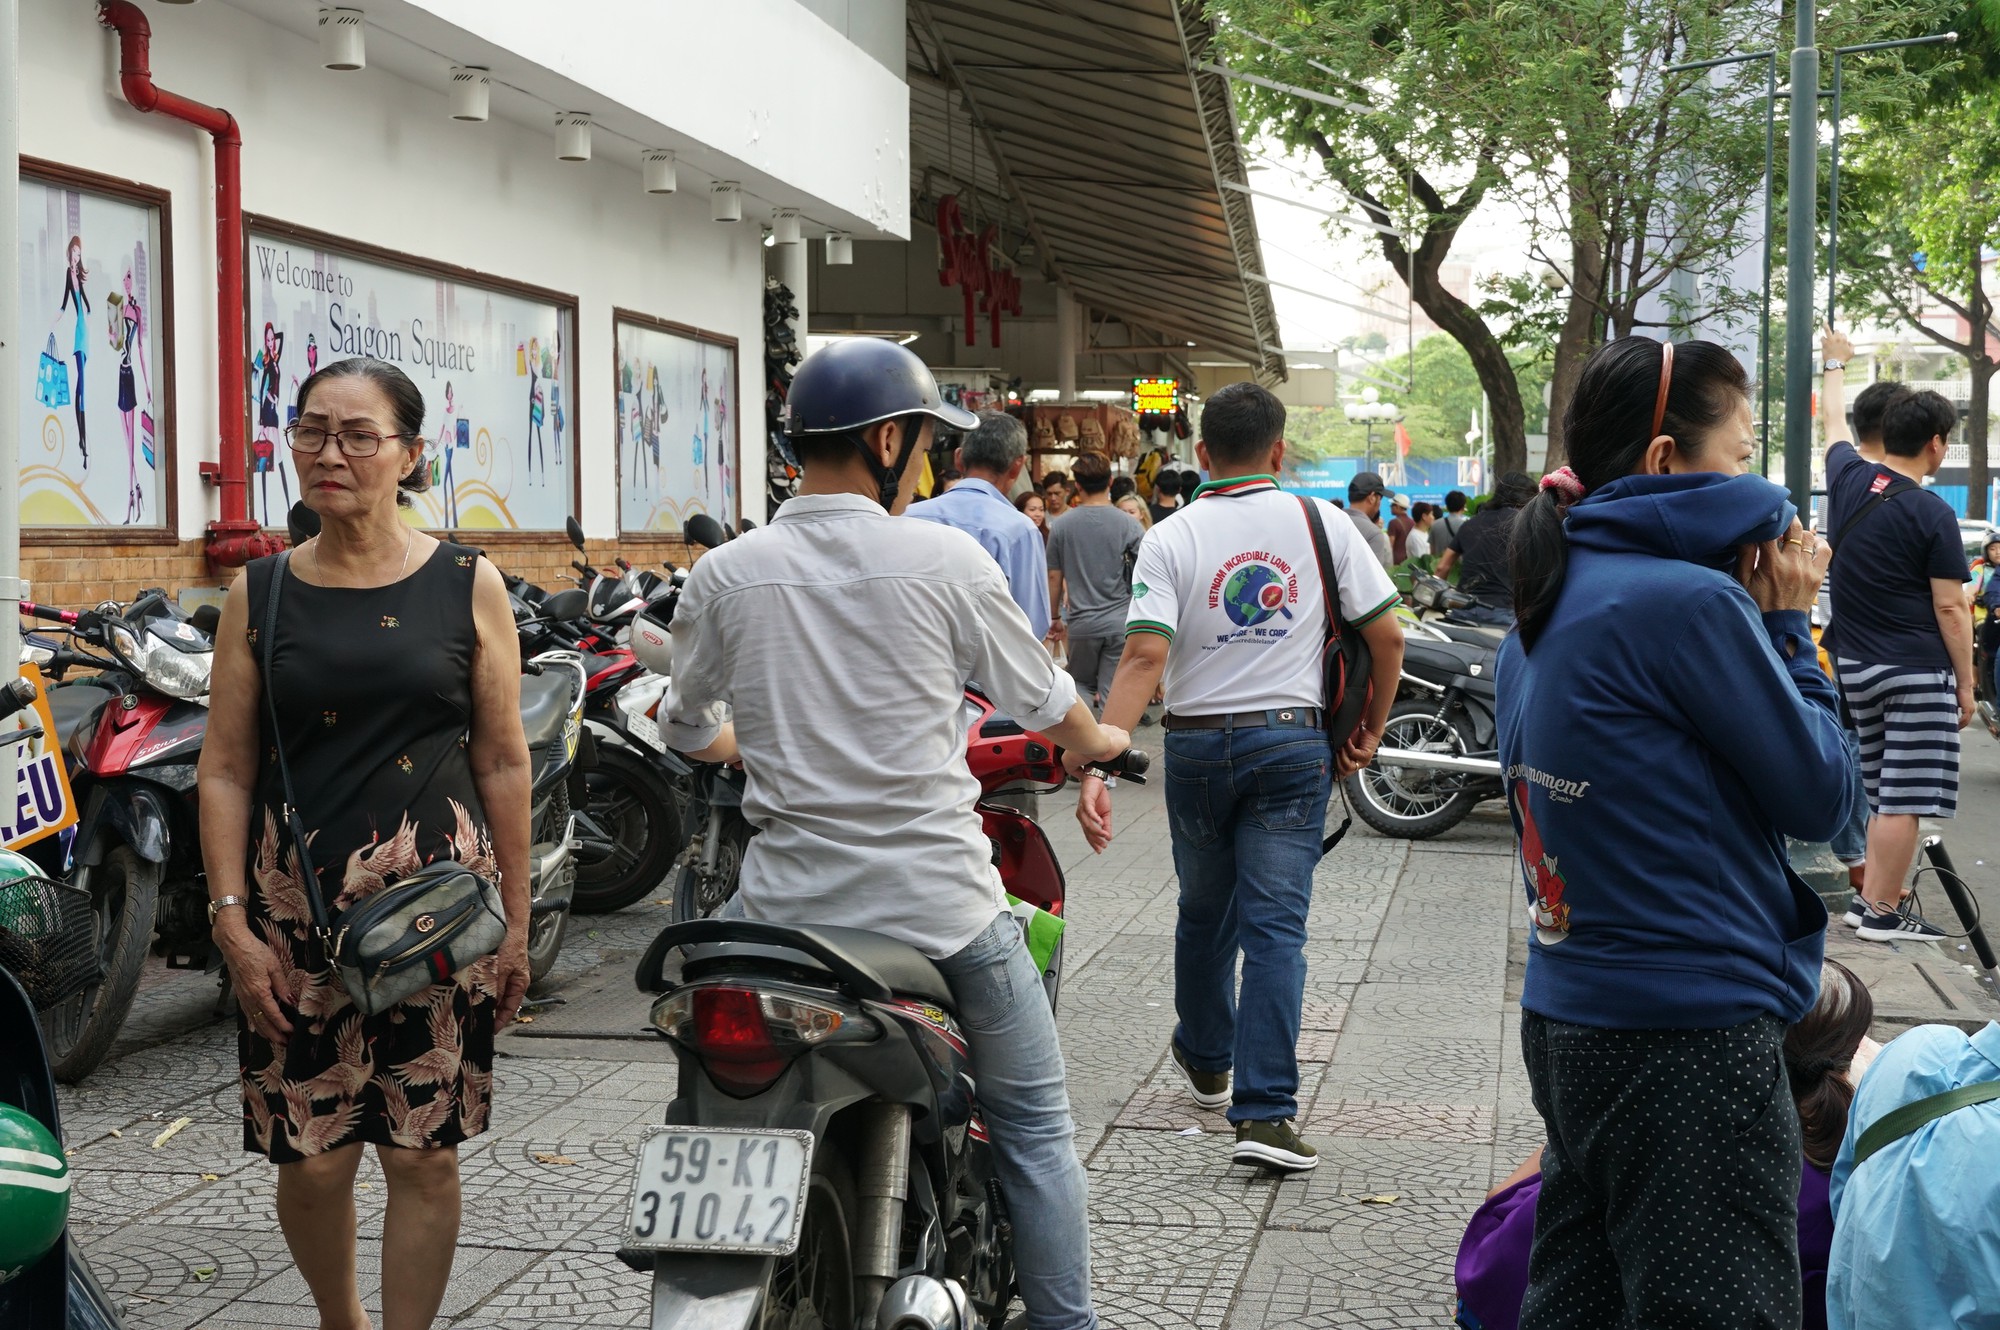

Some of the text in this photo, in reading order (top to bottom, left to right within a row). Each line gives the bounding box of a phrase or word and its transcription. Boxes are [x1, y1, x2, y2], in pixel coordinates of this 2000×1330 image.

[256, 245, 353, 297] Welcome to
[330, 302, 475, 378] Saigon Square
[1138, 383, 1173, 396] CURRENCY
[1138, 397, 1173, 409] EXCHANGE
[1208, 551, 1298, 609] VIETNAM INCREDIBLE LAND TOURS
[1217, 635, 1229, 643] WE
[1255, 628, 1267, 637] WE
[1268, 629, 1288, 638] CARE
[1529, 767, 1590, 798] moment
[661, 1136, 779, 1188] 59-K1
[635, 1190, 790, 1245] 310.42
